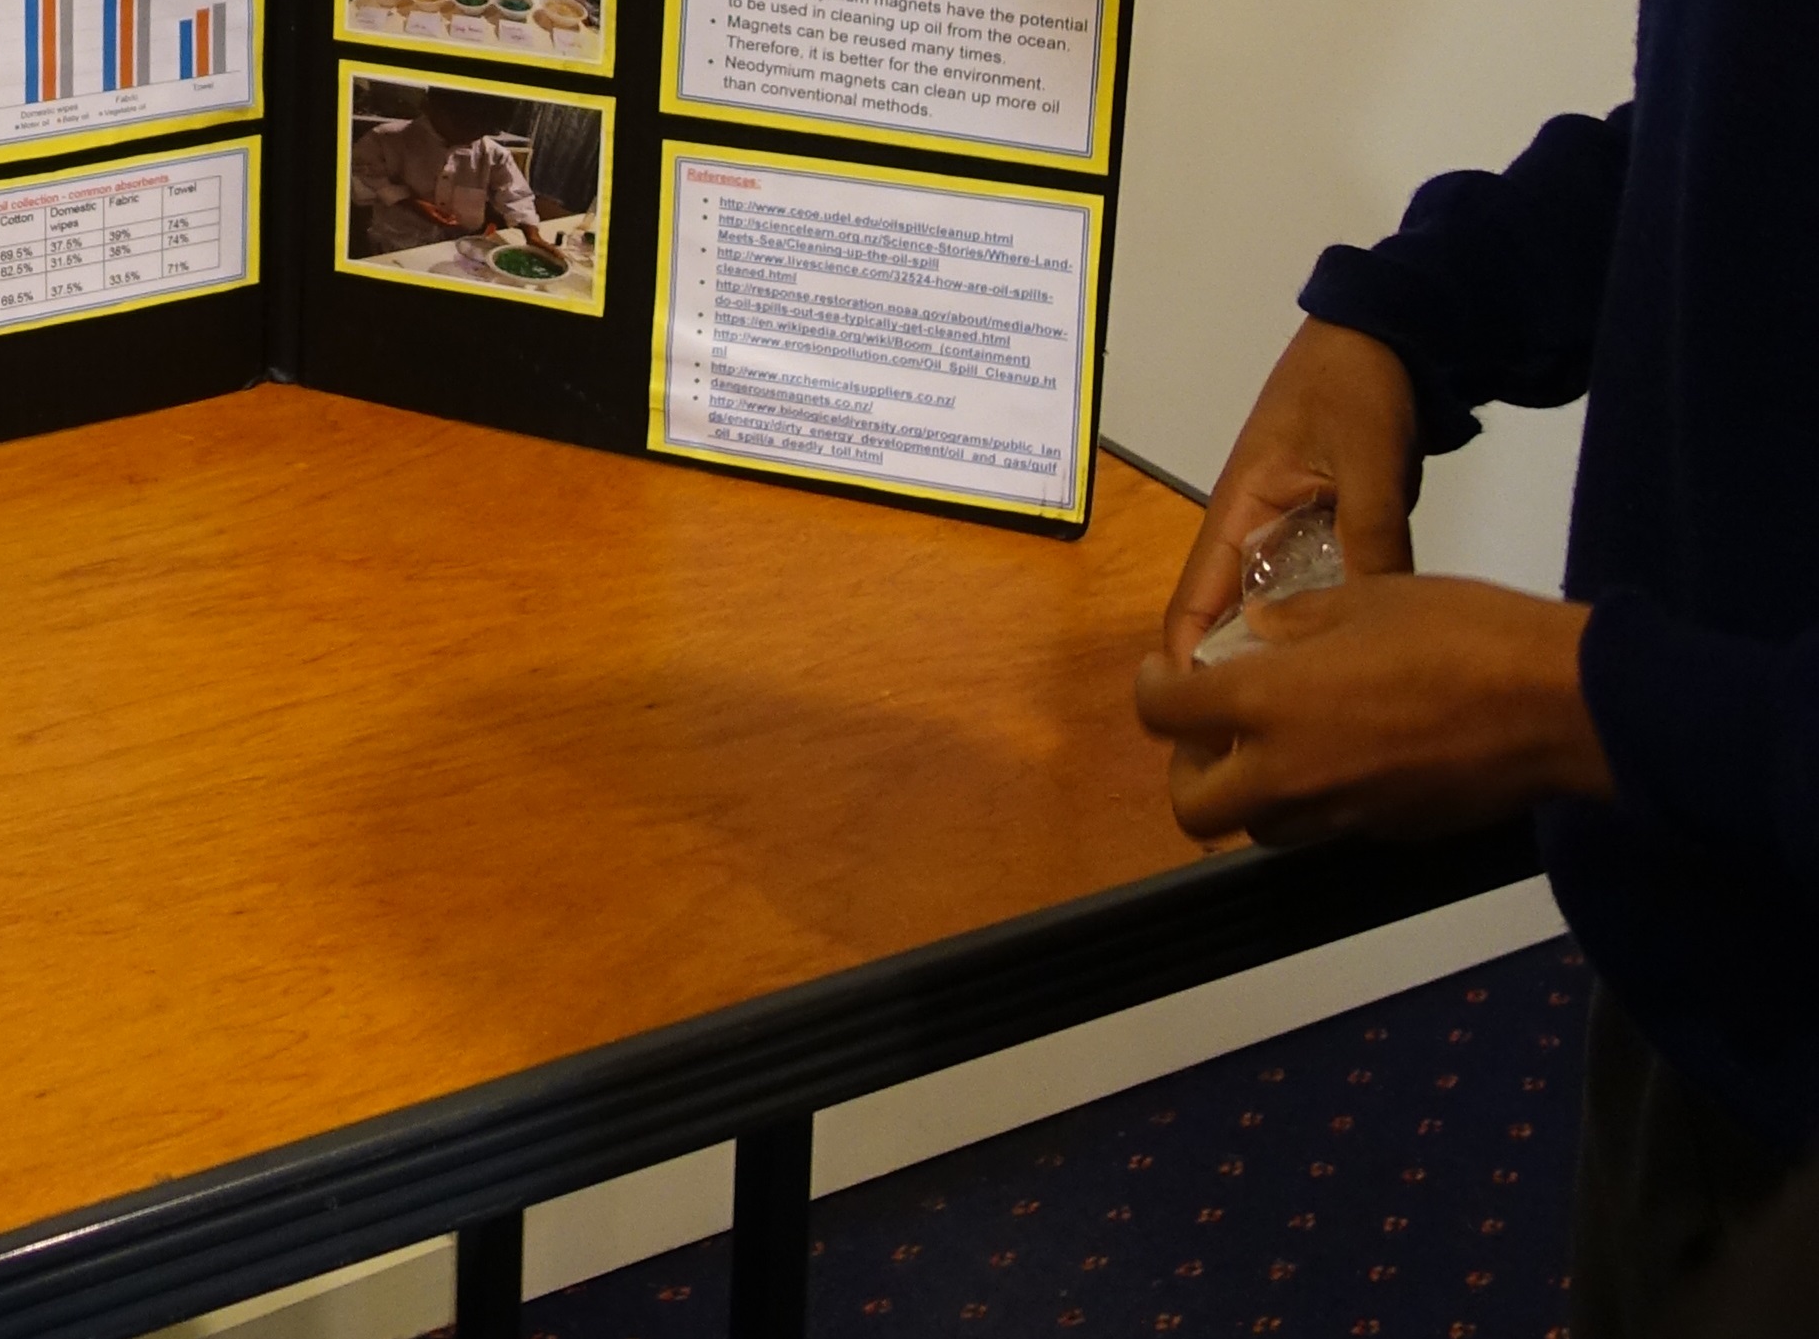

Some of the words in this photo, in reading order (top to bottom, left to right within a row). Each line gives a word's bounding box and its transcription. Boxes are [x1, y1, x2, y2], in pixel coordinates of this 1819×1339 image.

[723, 75, 756, 92] than
[760, 83, 857, 106] conventional
[862, 97, 932, 117] methods.
